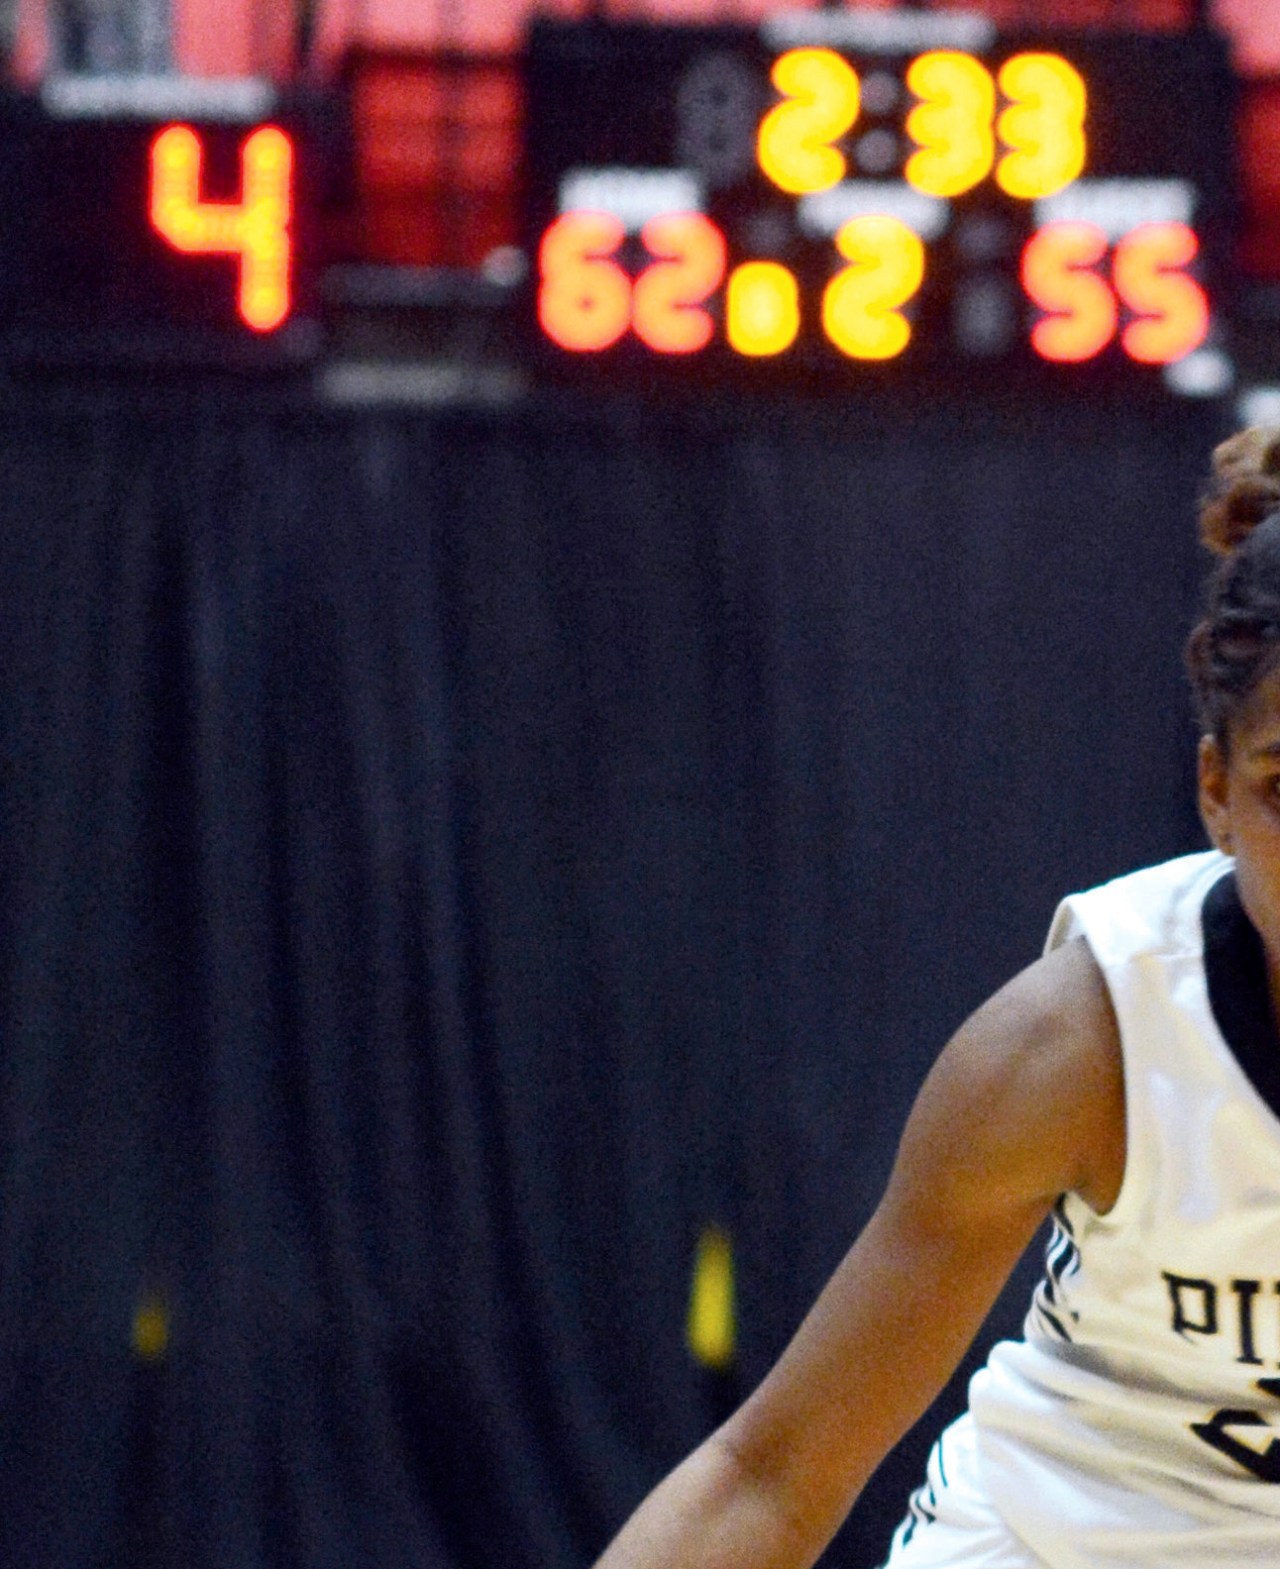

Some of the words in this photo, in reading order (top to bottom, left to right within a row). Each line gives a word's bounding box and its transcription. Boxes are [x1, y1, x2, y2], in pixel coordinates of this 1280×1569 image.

[150, 122, 293, 333] 4
[538, 210, 727, 354] 62
[822, 213, 926, 361] 2
[1020, 220, 1210, 364] 55
